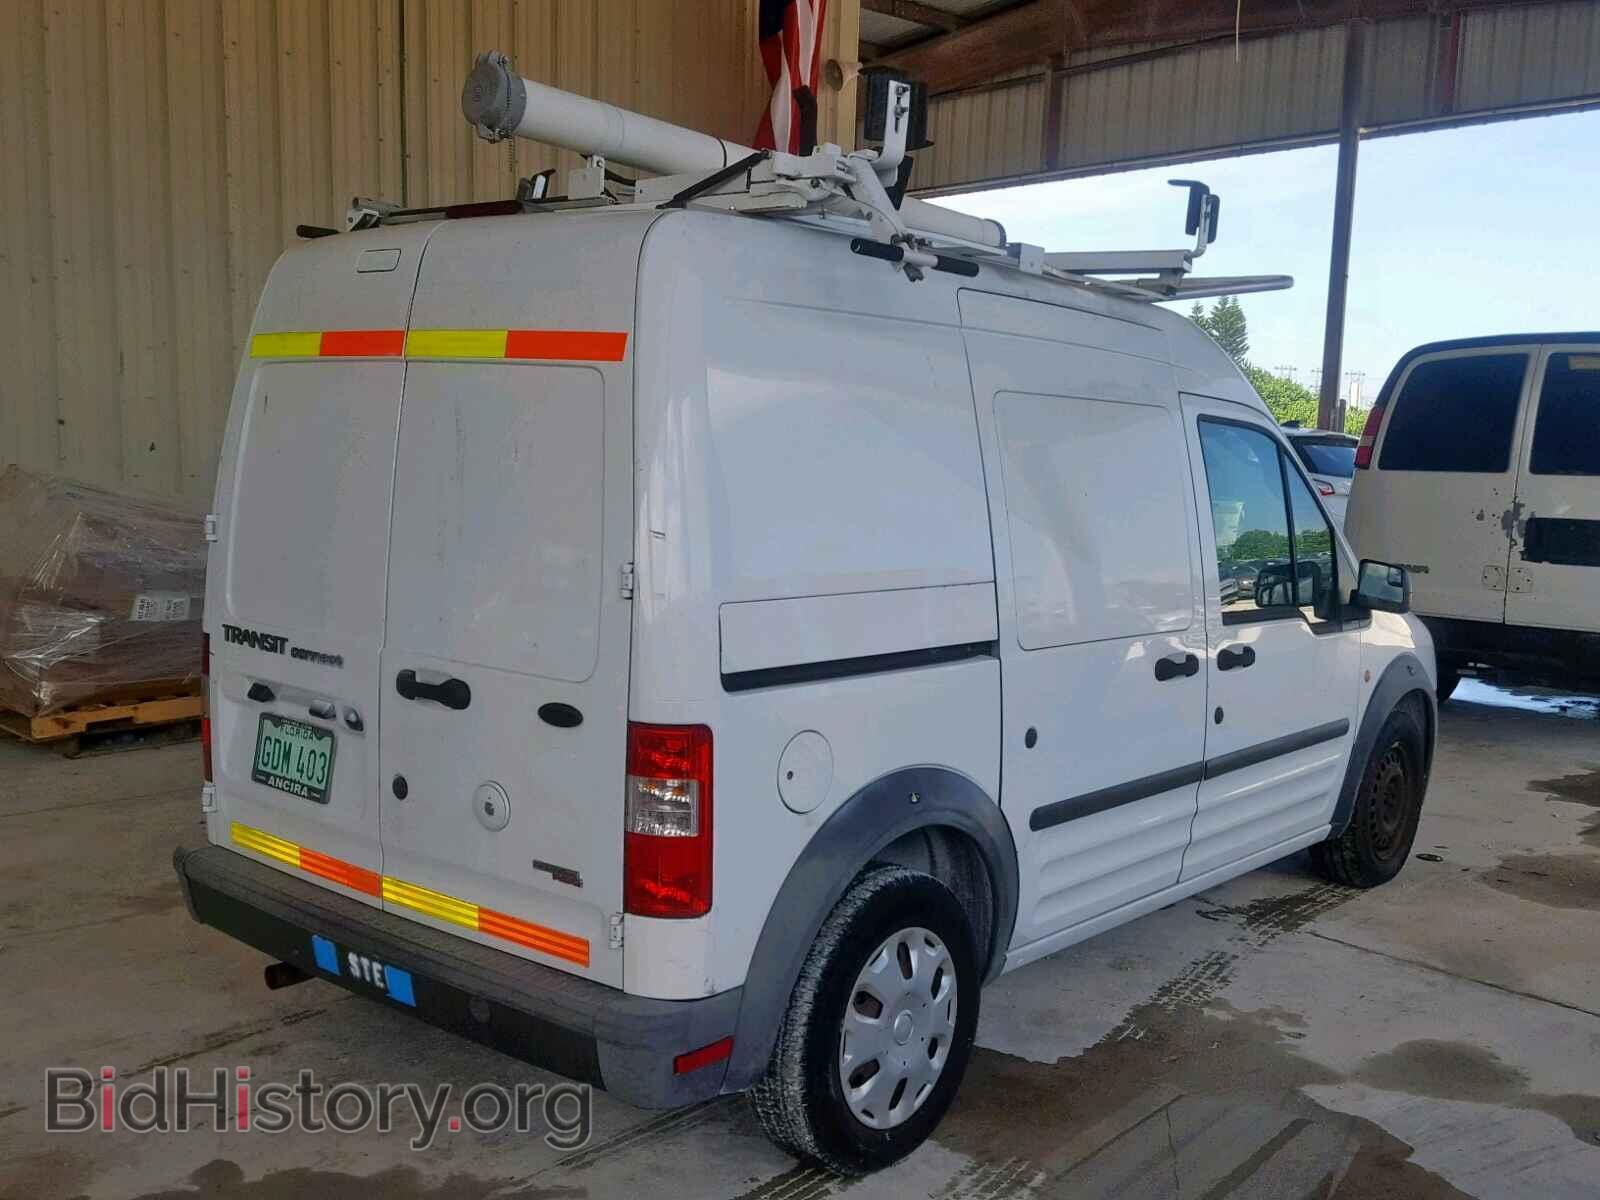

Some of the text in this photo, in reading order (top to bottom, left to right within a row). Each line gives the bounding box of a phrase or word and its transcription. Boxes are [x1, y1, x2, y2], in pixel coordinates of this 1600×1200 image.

[222, 624, 289, 655] TRANSIT
[261, 735, 328, 785] GDM 403
[267, 776, 310, 798] ANCIRA
